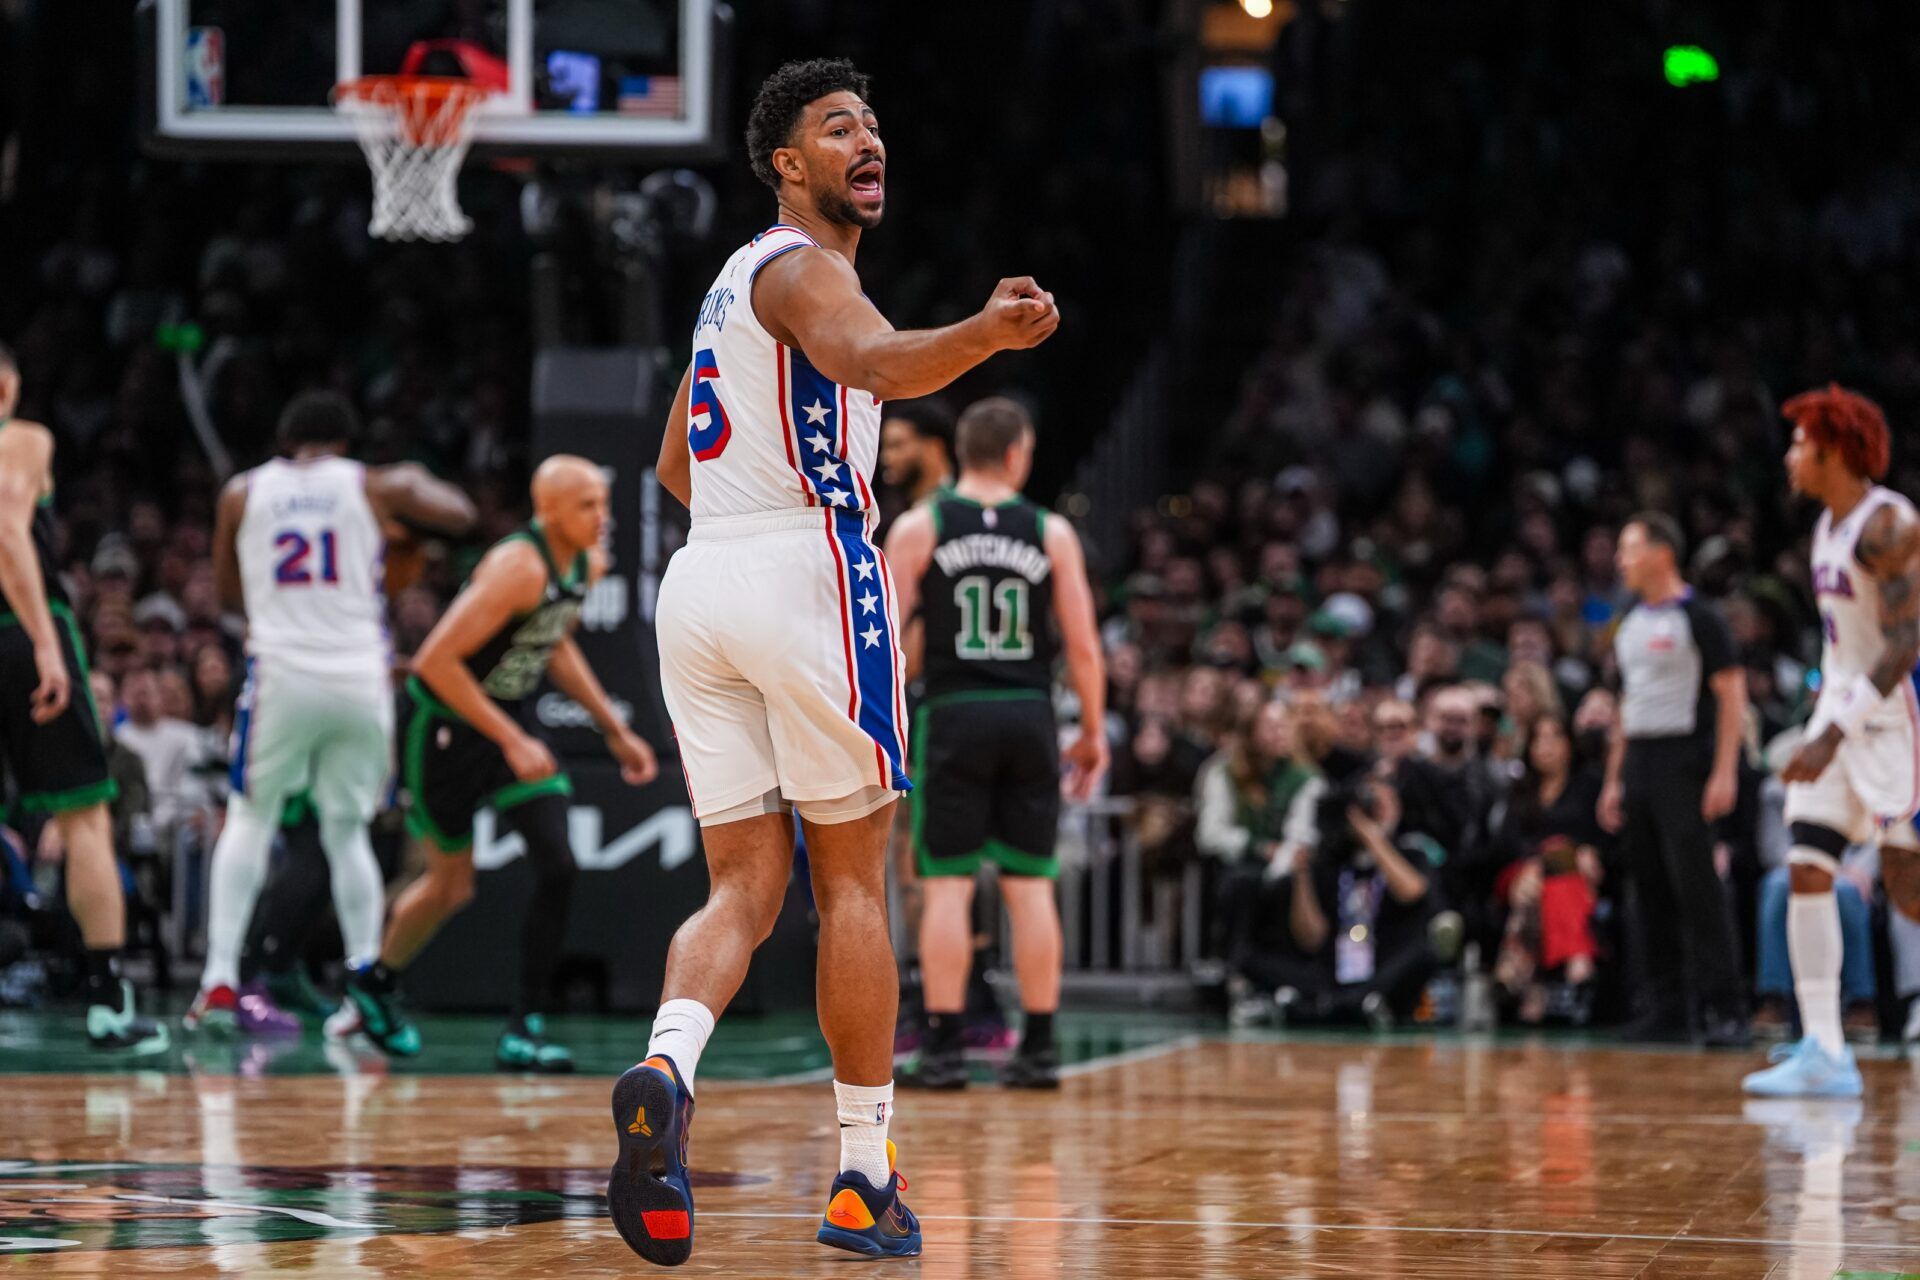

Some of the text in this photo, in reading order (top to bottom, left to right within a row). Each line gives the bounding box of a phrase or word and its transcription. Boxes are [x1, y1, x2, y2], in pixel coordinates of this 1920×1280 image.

[694, 287, 735, 340] RIMES
[688, 347, 732, 463] 5
[273, 530, 338, 584] 21
[934, 532, 1052, 585] PRITCHARD
[953, 575, 1034, 661] 11
